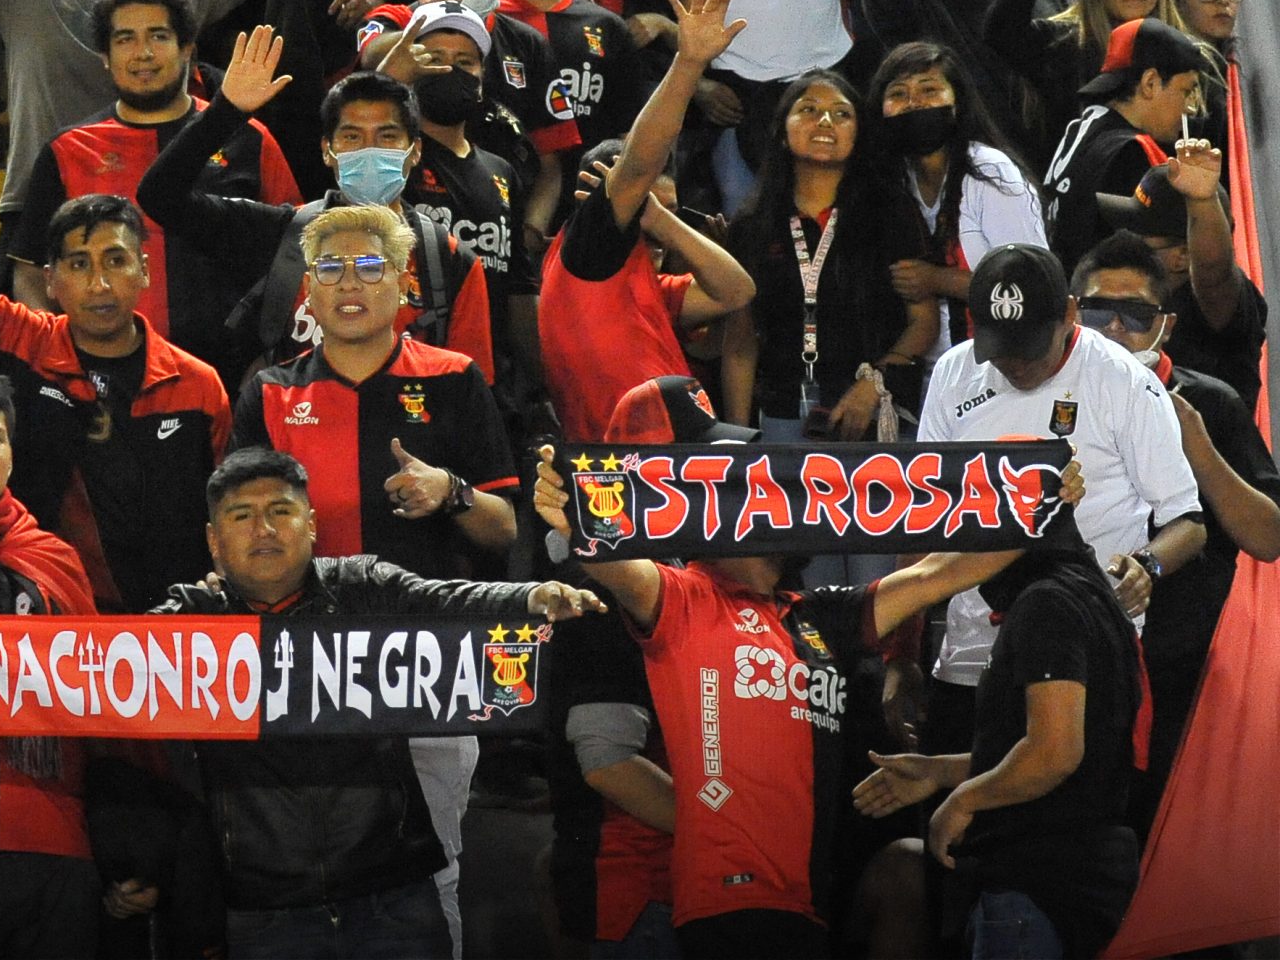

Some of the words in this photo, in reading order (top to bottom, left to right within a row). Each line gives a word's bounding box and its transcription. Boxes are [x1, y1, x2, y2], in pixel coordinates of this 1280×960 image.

[160, 418, 180, 430] NIKE
[734, 623, 771, 635] WALON
[488, 646, 503, 654] FBC
[504, 646, 533, 654] MELGAR
[311, 630, 482, 724] NEGRA
[699, 667, 722, 777] GENERADE
